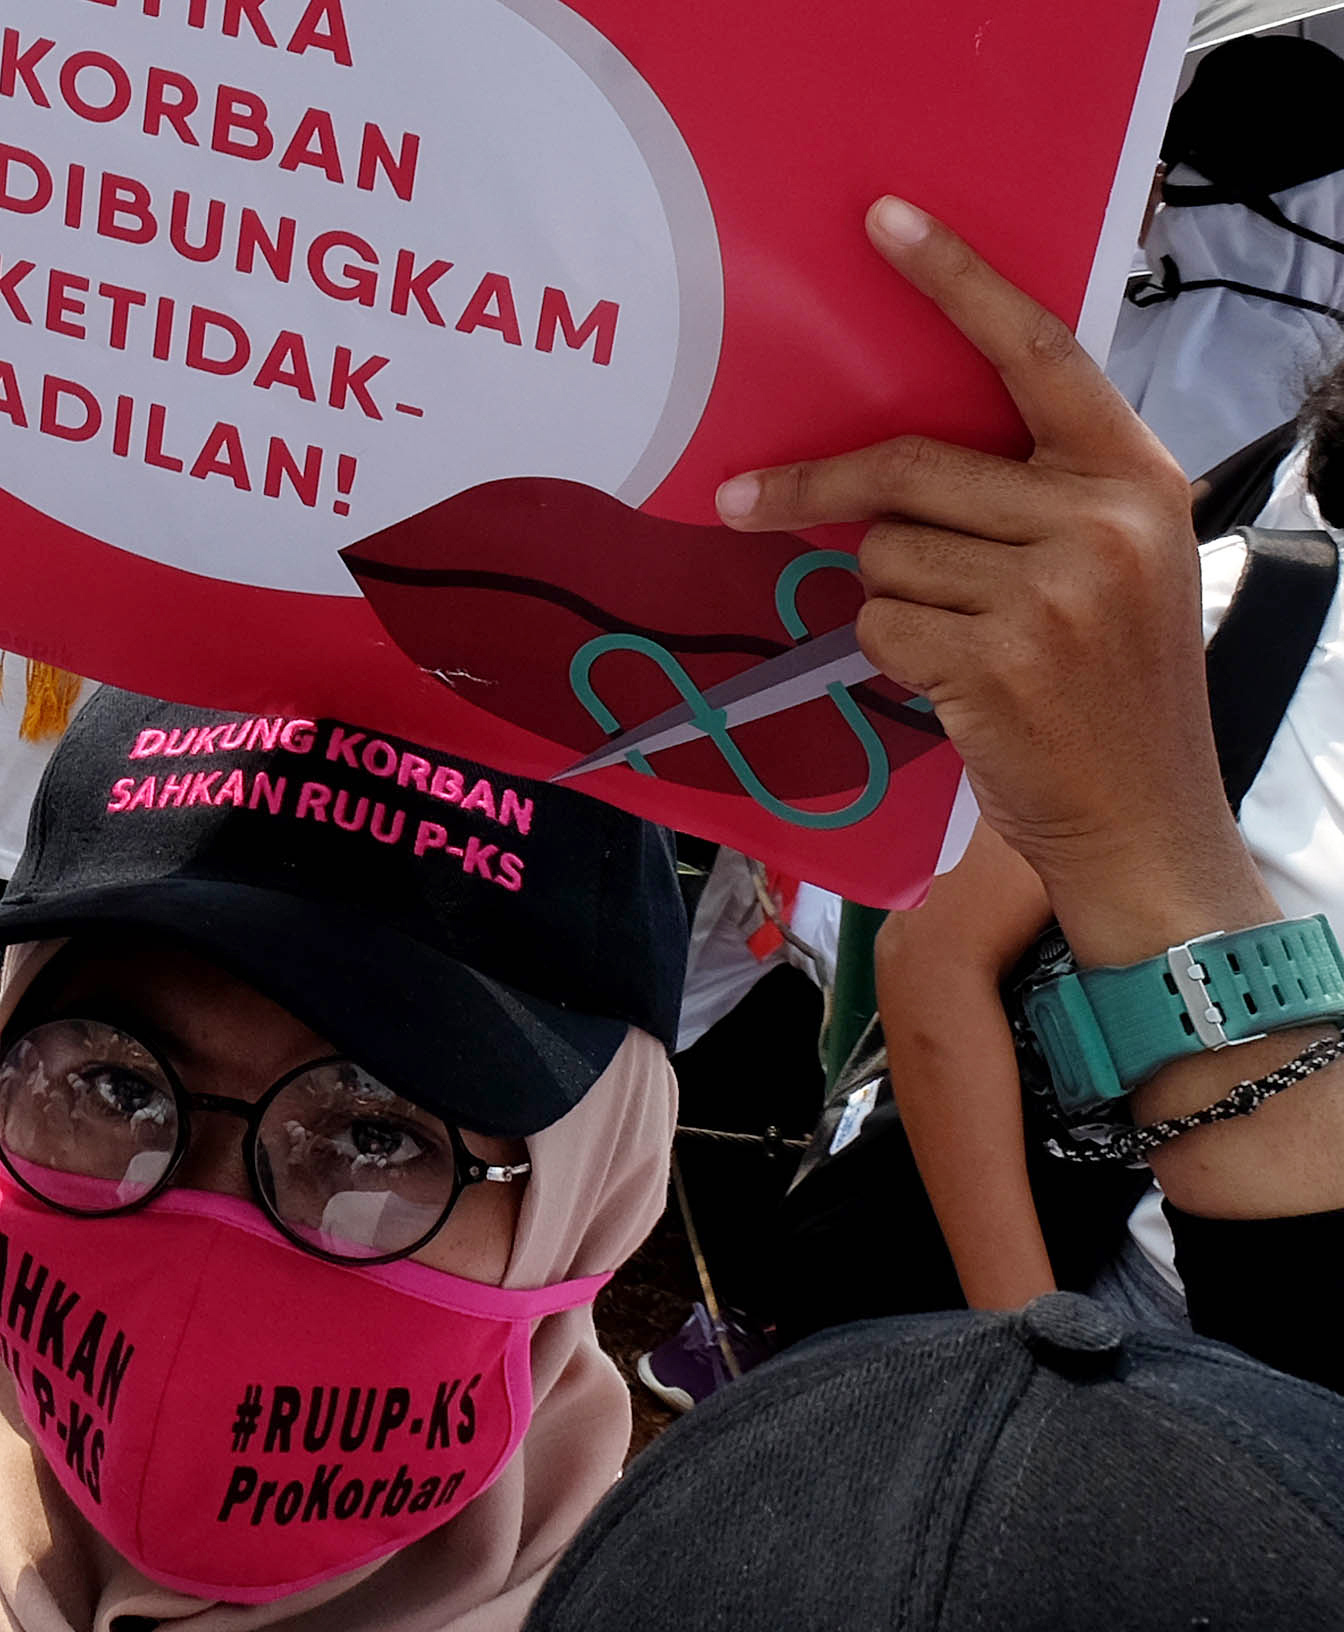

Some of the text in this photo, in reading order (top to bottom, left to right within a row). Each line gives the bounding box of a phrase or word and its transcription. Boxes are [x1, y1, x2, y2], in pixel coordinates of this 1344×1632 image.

[107, 768, 526, 892] SAHKAN RUU P-KS
[128, 717, 535, 835] DUKUNG KORBAN
[31, 1367, 105, 1504] P-KS
[230, 1372, 483, 1453] #RUUP-KS
[216, 1465, 467, 1526] ProKorban
